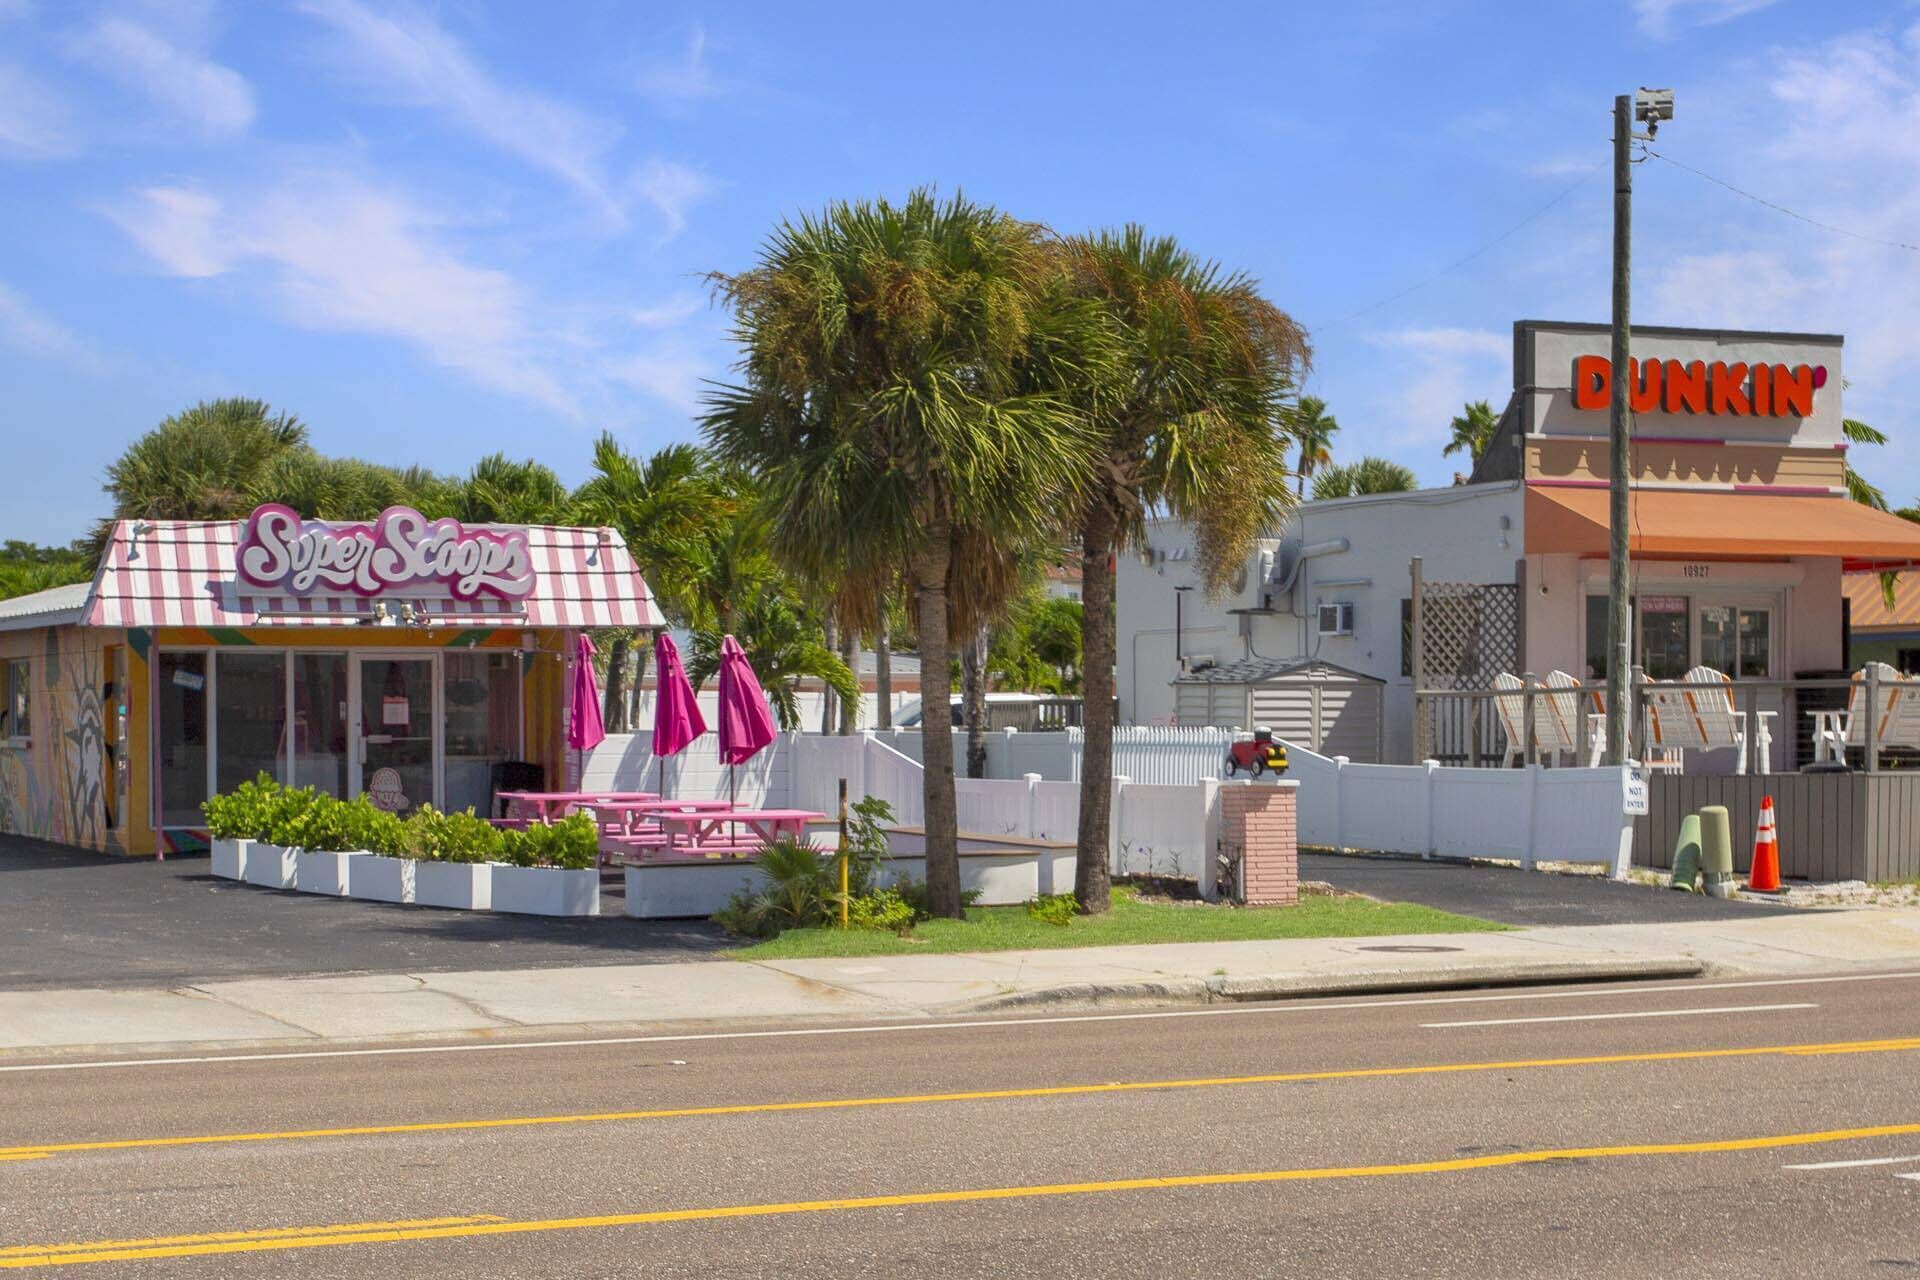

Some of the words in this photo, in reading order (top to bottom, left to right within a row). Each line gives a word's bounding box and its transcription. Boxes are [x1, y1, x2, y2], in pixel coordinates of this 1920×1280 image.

[1571, 355, 1827, 417] DUNKIN'
[243, 511, 381, 591] Super
[373, 512, 533, 596] Scoops
[1683, 565, 1710, 578] 10927
[1630, 771, 1641, 781] DO
[1629, 786, 1643, 797] NOT
[1627, 800, 1645, 809] ENTER
